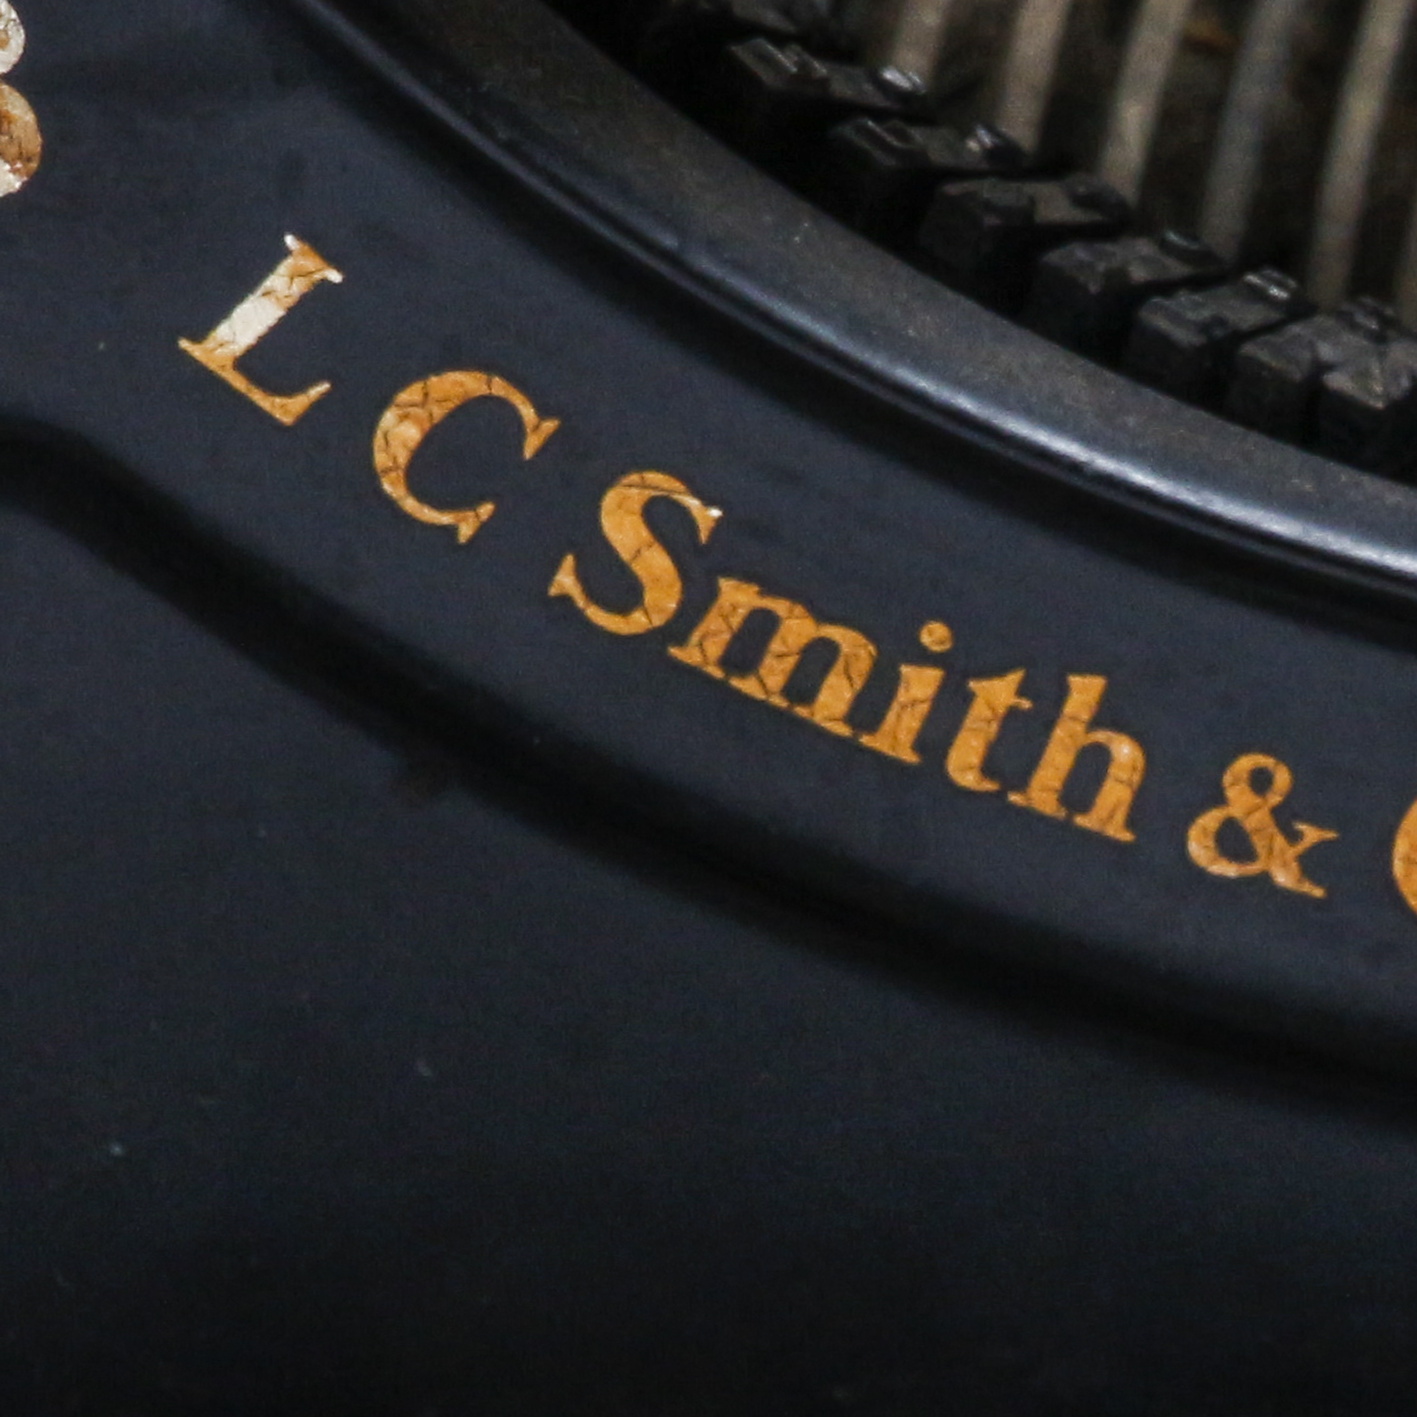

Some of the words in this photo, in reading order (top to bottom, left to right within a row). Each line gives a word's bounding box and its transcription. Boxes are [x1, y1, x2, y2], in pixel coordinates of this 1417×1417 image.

[178, 234, 344, 425] L
[373, 371, 560, 543] C
[548, 469, 1150, 841] Smith
[1187, 753, 1337, 897] &
